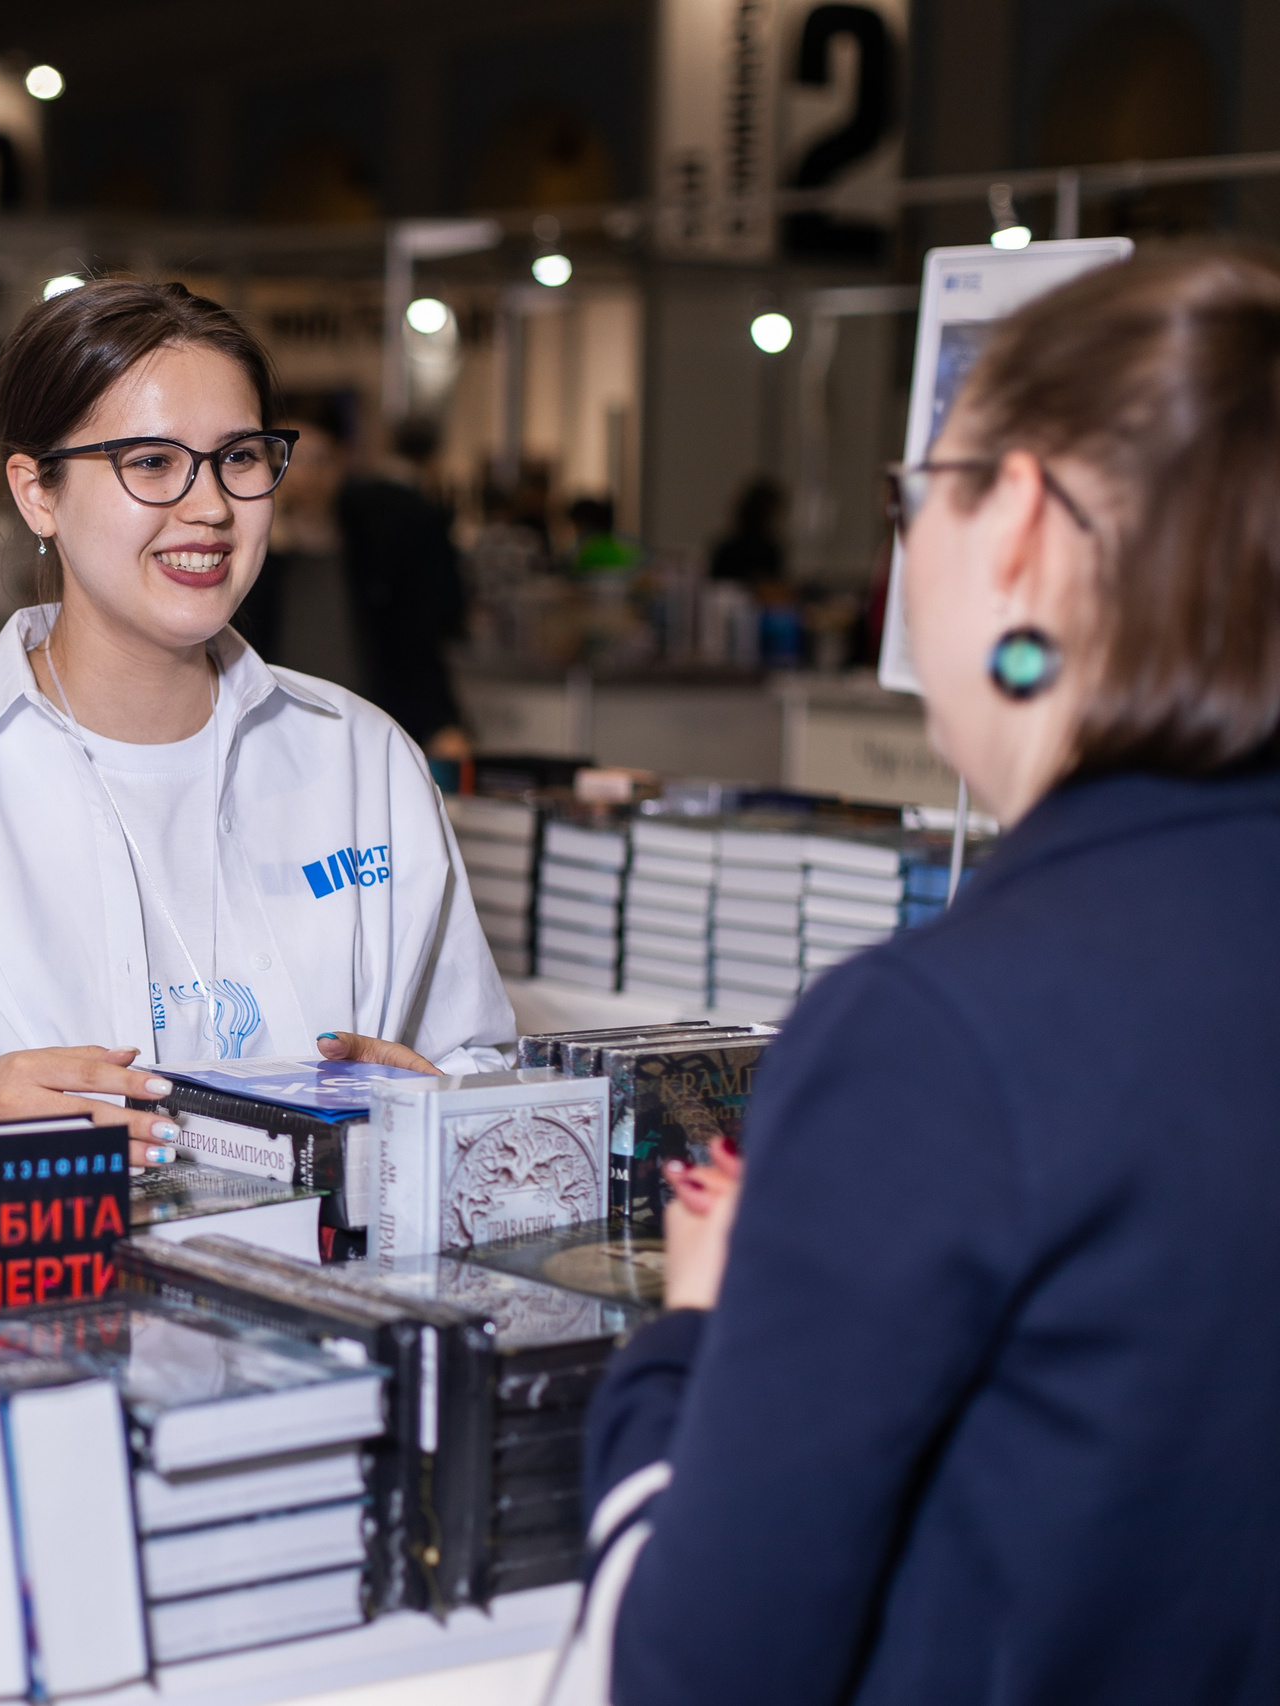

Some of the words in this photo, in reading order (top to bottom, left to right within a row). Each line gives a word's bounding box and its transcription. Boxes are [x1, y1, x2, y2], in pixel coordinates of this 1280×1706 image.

[784, 4, 892, 256] 2
[2, 1152, 124, 1181] ХЭДФИЛД
[168, 1129, 219, 1155] МПЕРИЯ
[220, 1139, 285, 1170] ВАМПИРОВ
